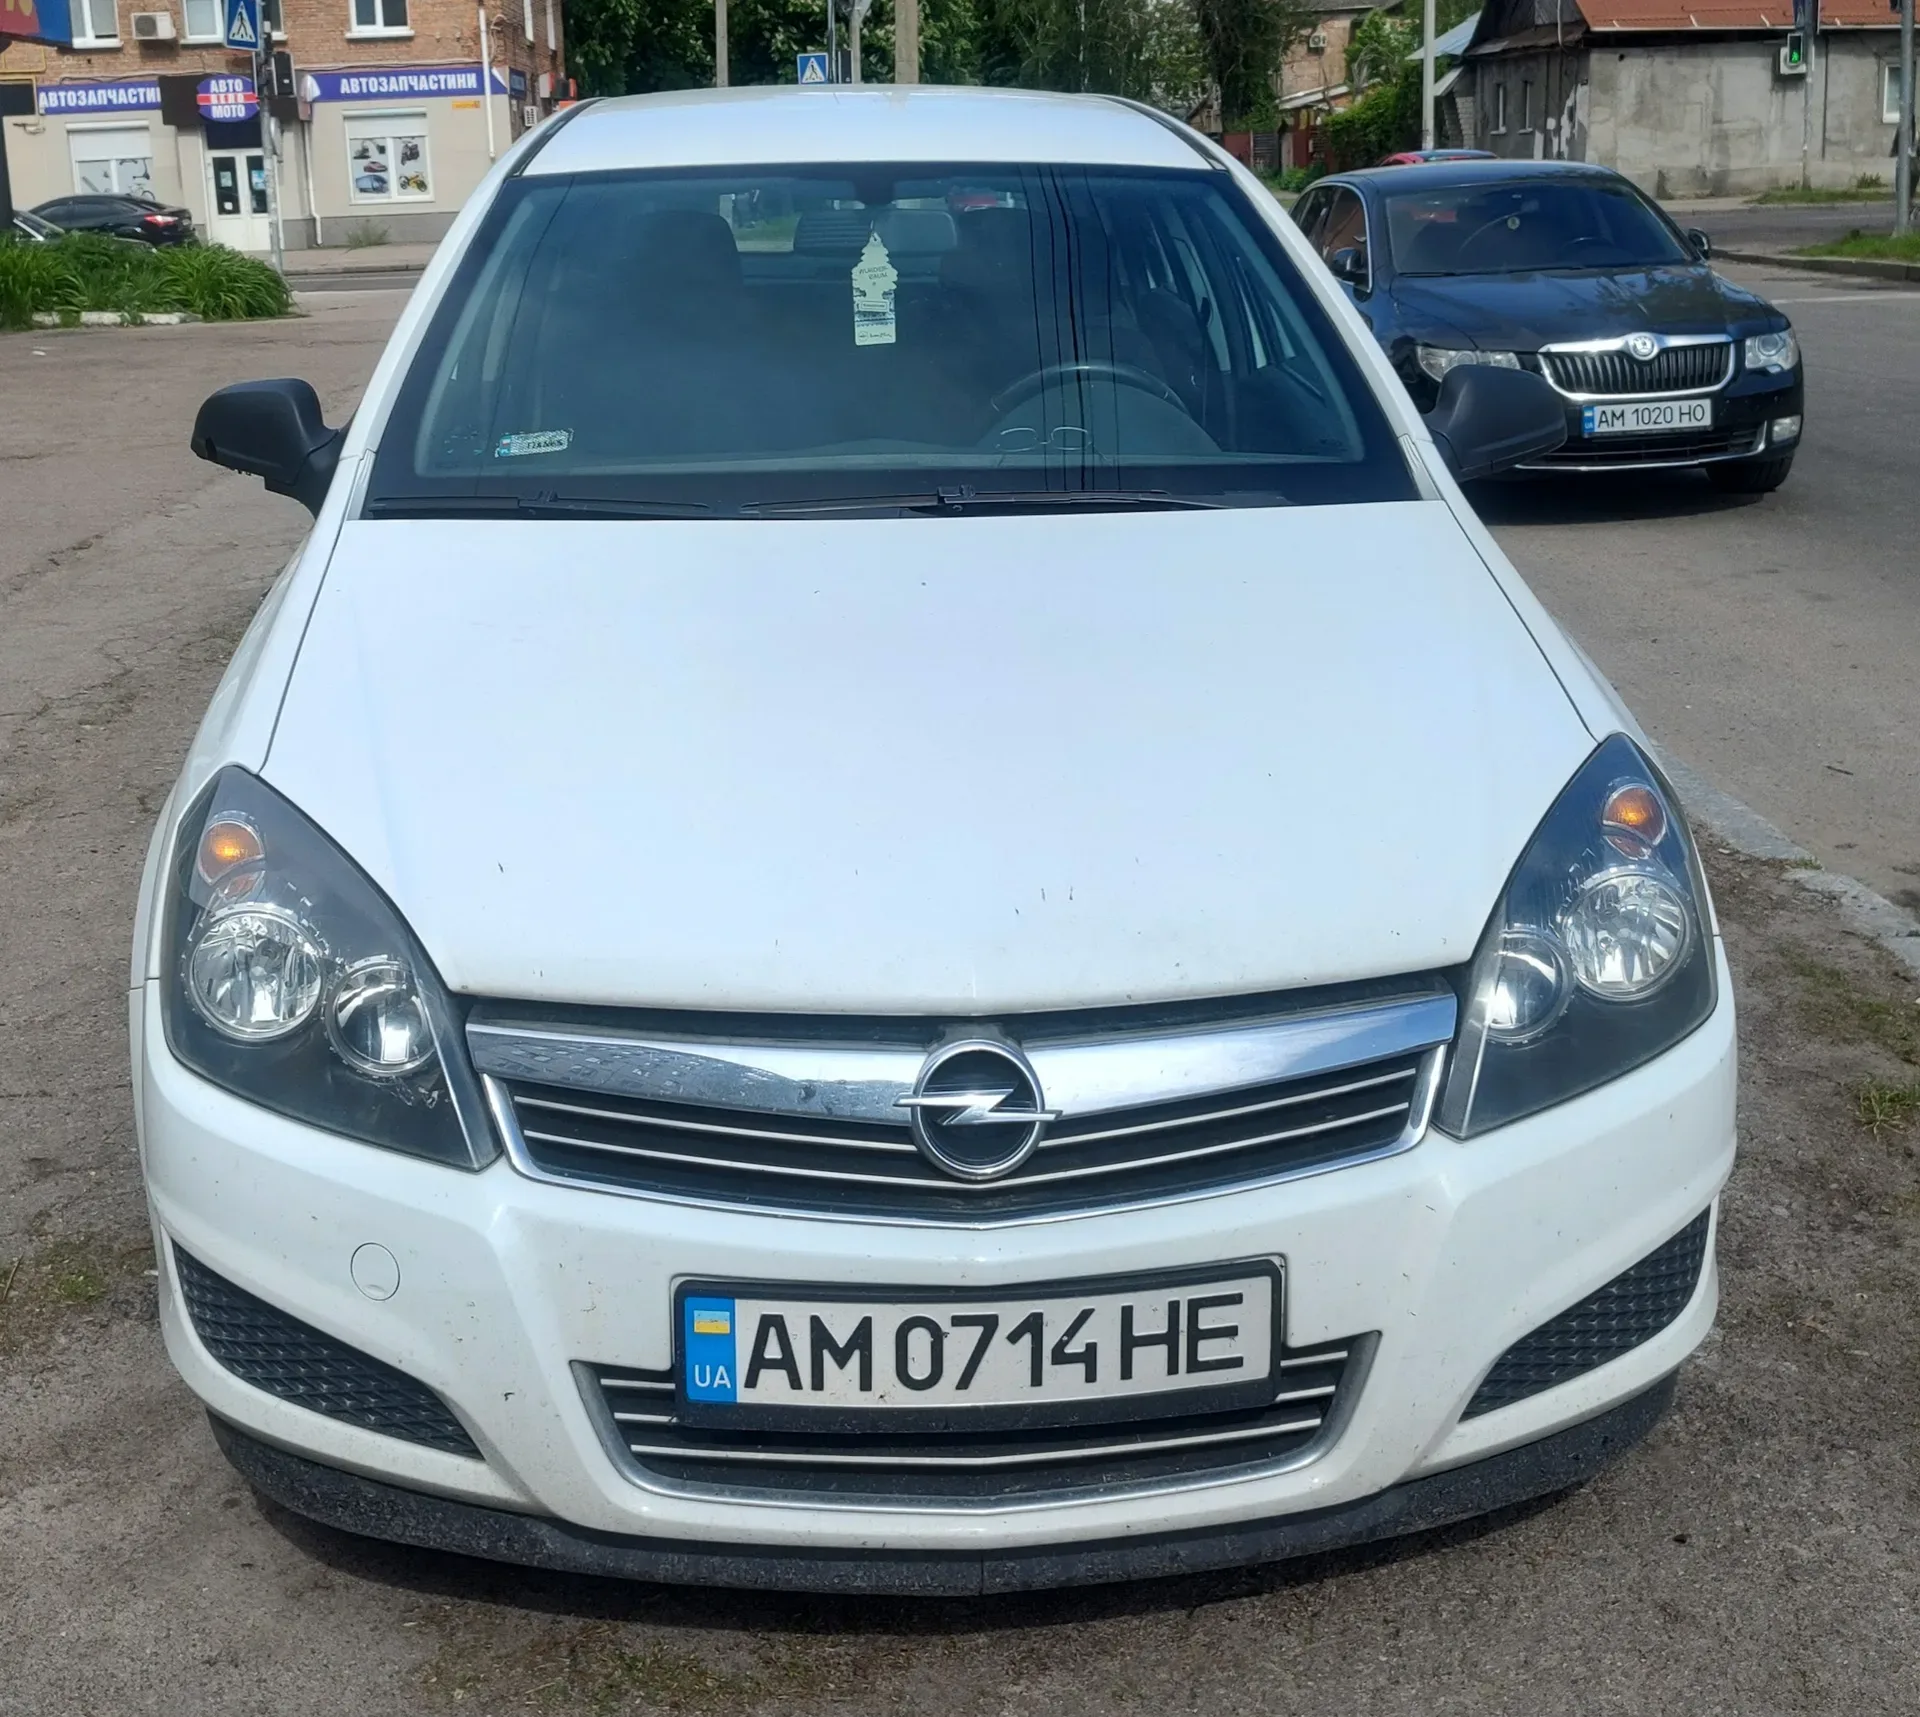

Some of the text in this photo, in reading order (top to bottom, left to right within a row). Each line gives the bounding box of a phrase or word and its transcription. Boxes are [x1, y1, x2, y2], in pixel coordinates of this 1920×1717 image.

[210, 79, 243, 93] АВТО
[340, 73, 477, 94] АВТОЗАПЧАСТИНИ
[212, 104, 246, 119] МОТО
[1598, 404, 1705, 428] AM 1020 HO
[743, 1292, 1244, 1391] AM 0714 HE
[693, 1364, 732, 1389] UA
